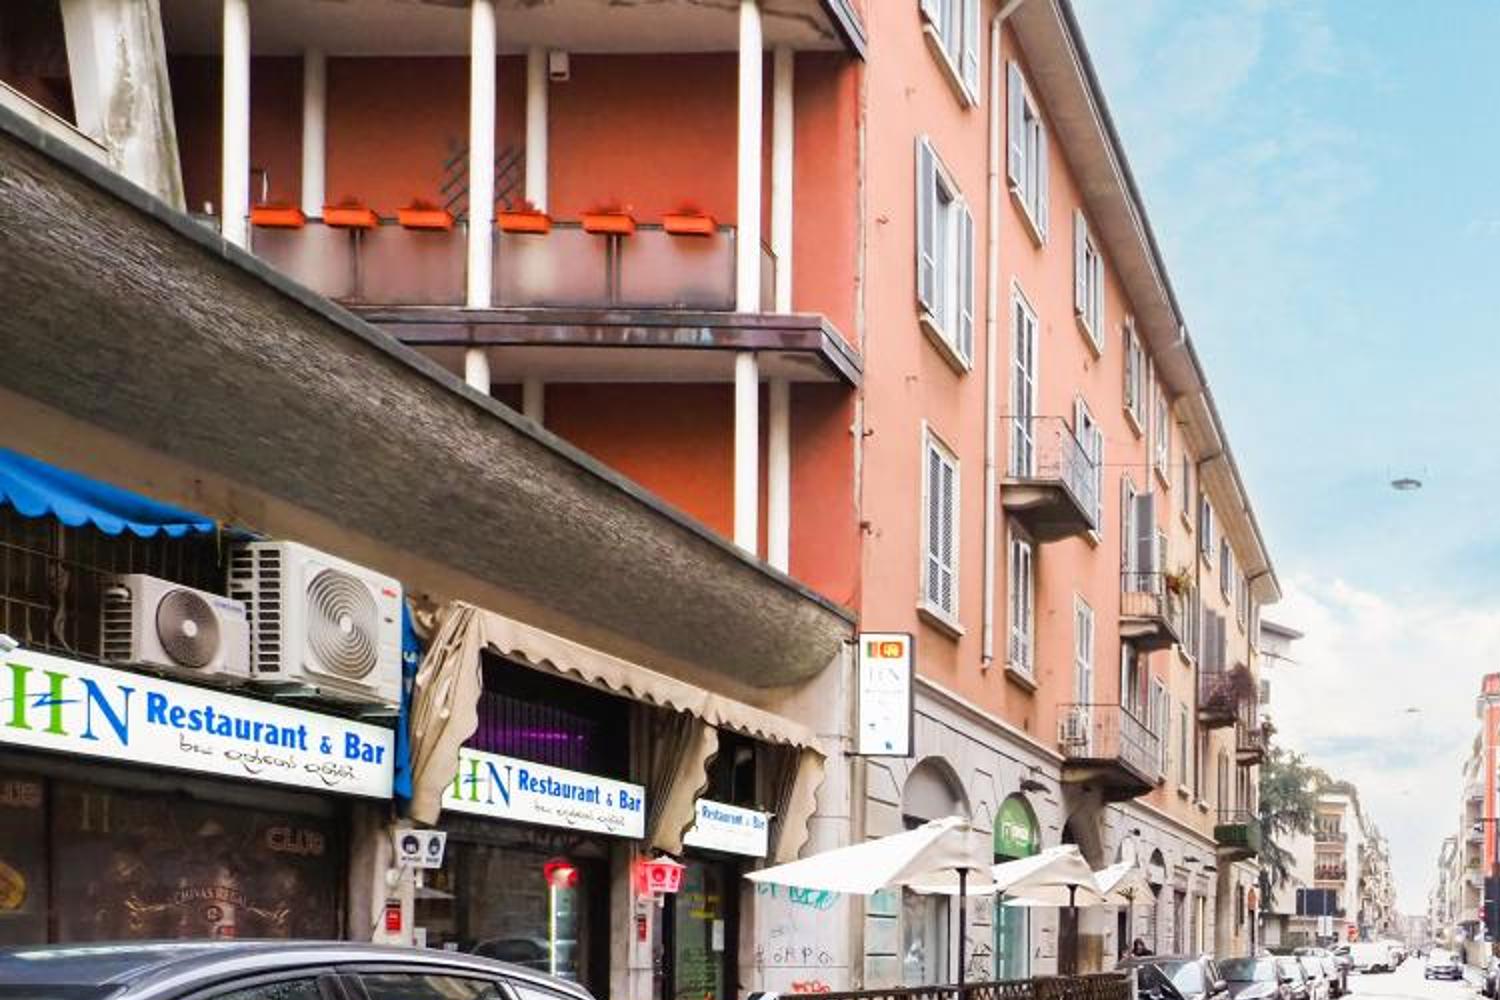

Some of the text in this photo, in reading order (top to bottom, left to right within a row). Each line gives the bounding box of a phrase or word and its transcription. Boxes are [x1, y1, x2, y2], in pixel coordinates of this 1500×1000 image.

[147, 691, 308, 751] Restaurant
[319, 735, 333, 755] &
[345, 732, 385, 765] Bar
[518, 769, 600, 805] Restaurant
[619, 789, 641, 812] Bar
